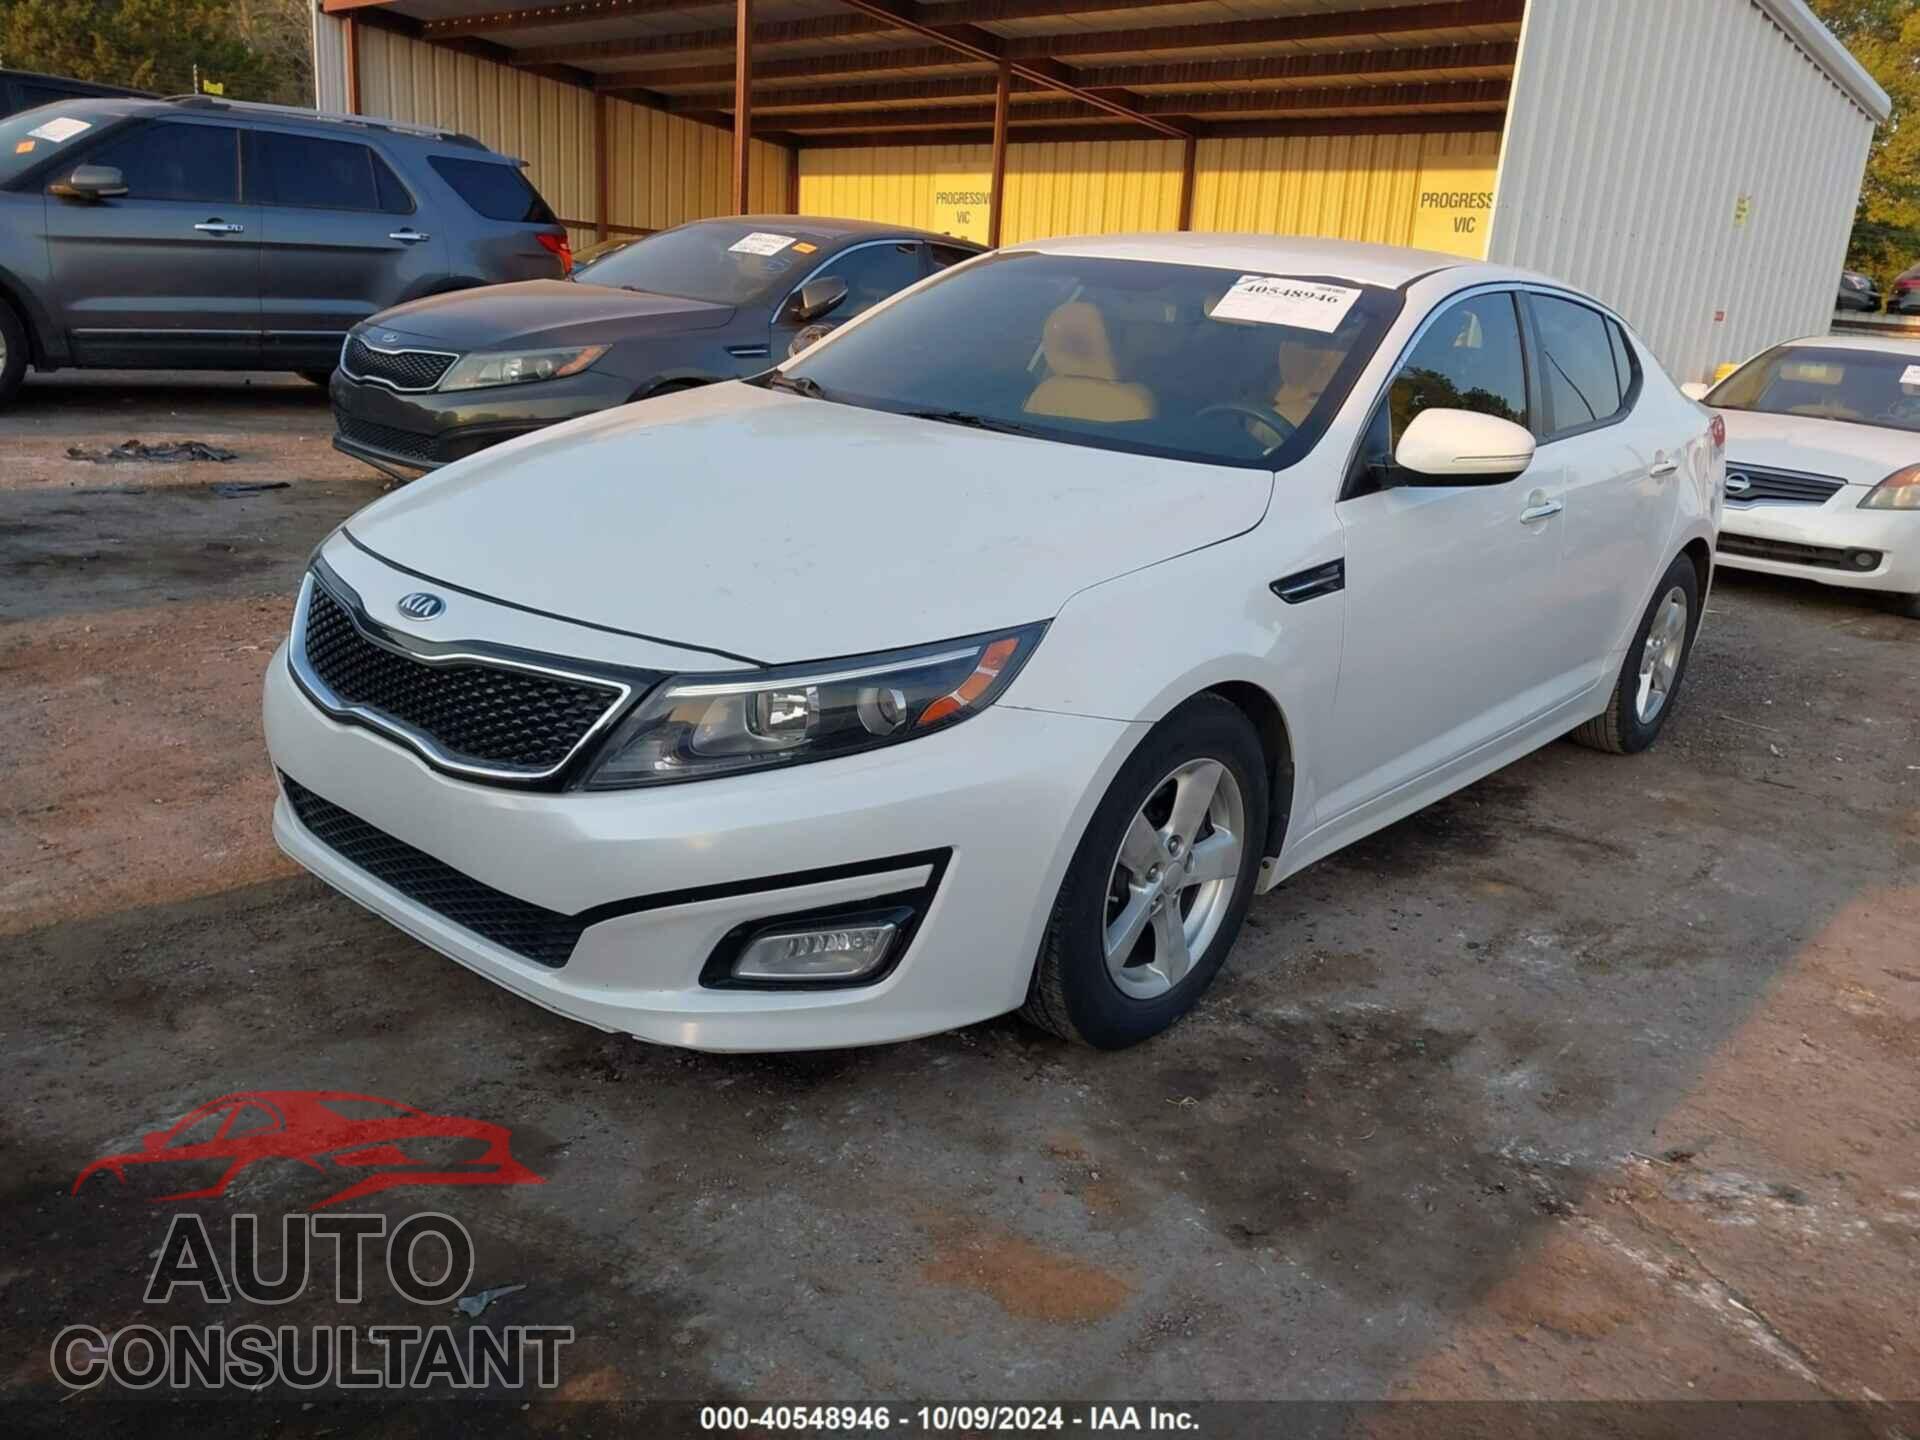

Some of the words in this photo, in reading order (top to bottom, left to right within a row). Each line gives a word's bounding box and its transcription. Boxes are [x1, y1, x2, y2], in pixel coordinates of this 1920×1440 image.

[956, 211, 971, 225] VIC
[1454, 216, 1476, 233] VIC
[1243, 284, 1339, 304] 40548946
